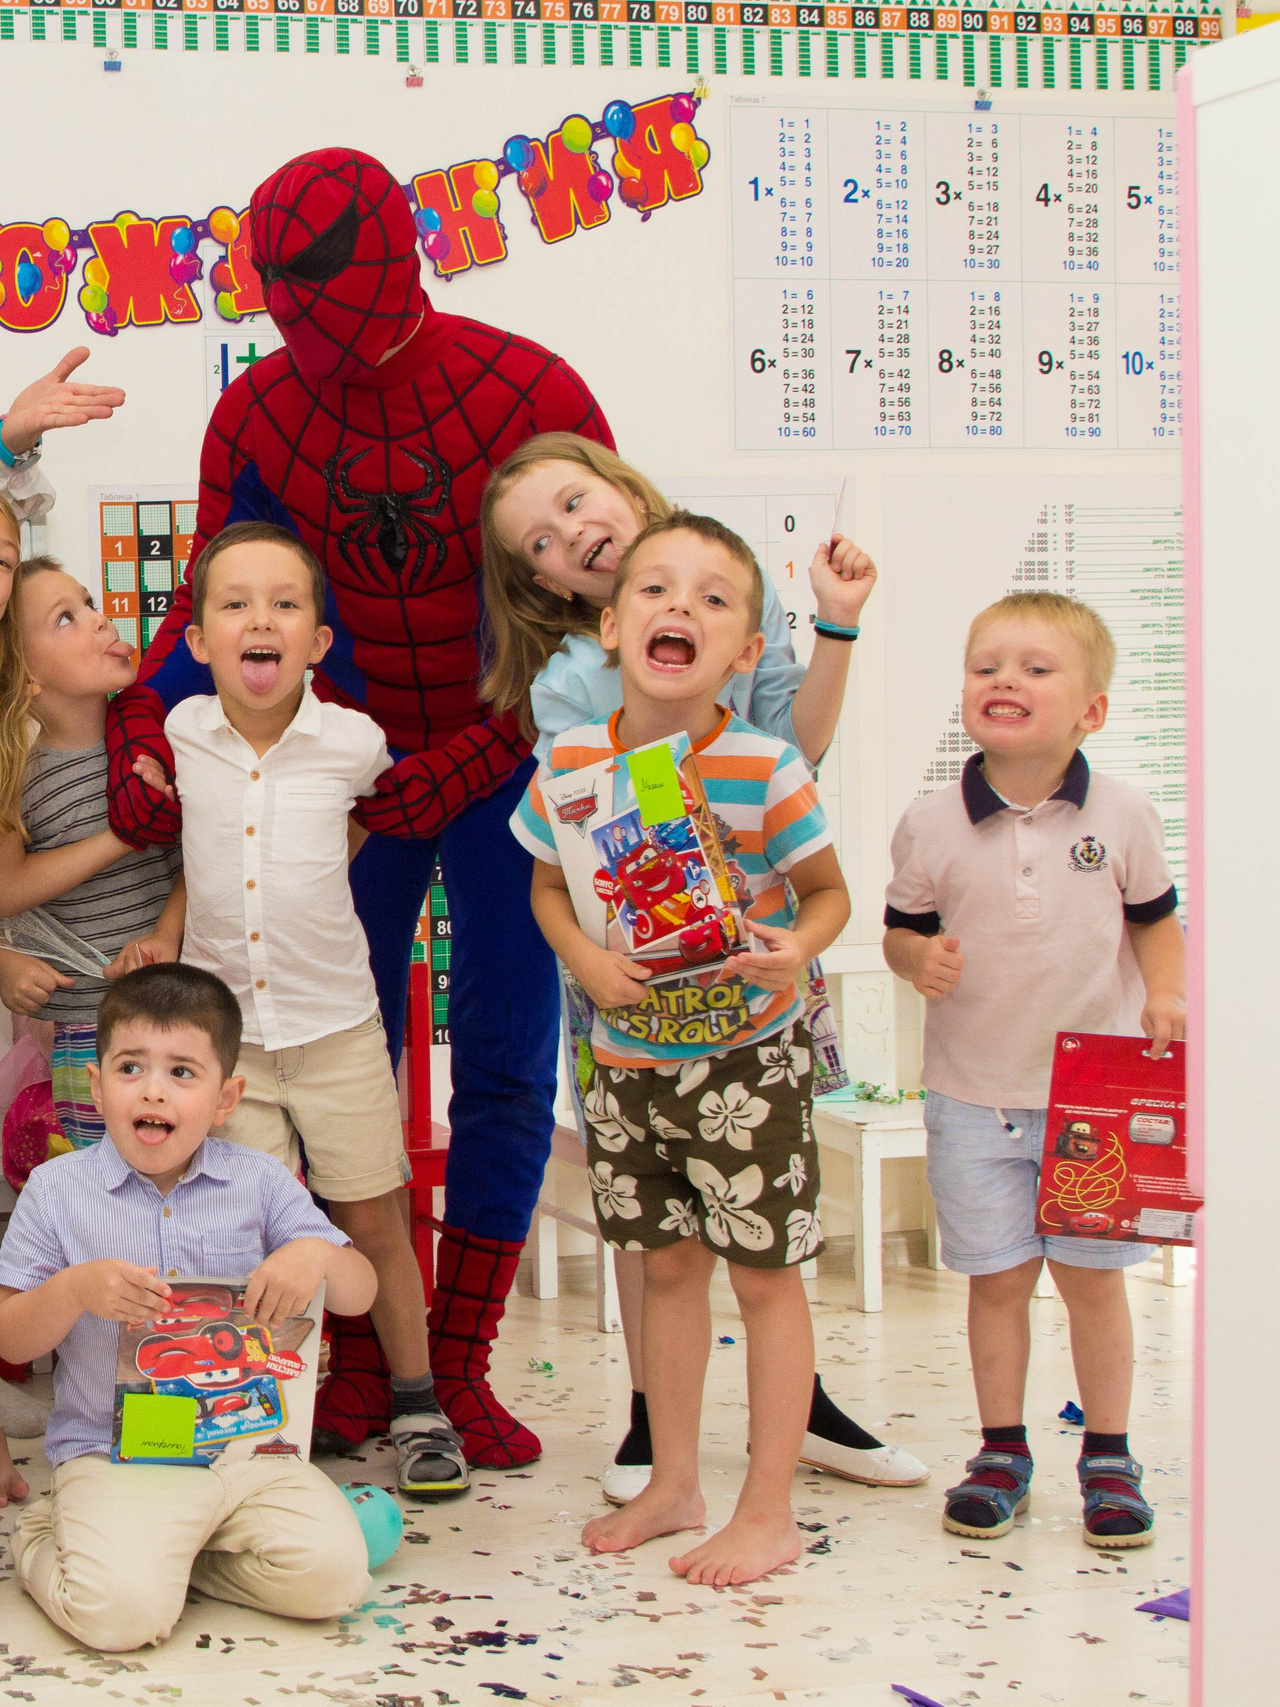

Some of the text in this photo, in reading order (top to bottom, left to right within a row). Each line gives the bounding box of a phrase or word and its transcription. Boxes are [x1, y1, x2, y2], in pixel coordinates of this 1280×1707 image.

[398, 0, 1218, 35] 70 71 72 73 74 75 76 77 78 79 80 81 82 83 84 85 86 87 88 89 90 91 92 93 94 95 96 97 98 99
[100, 492, 132, 501] Таблица
[784, 515, 795, 532] 0
[115, 542, 123, 556] 1
[150, 541, 161, 555] 2
[785, 561, 794, 578] 1
[112, 597, 167, 612] 11 12
[786, 612, 797, 629] 2
[639, 985, 745, 1015] ATROL
[658, 1006, 749, 1044] ROLL!
[1064, 1040, 1077, 1049] 3+
[1130, 1098, 1175, 1109] ФРЕСКА
[267, 1361, 300, 1378] БЛЕСТКИ
